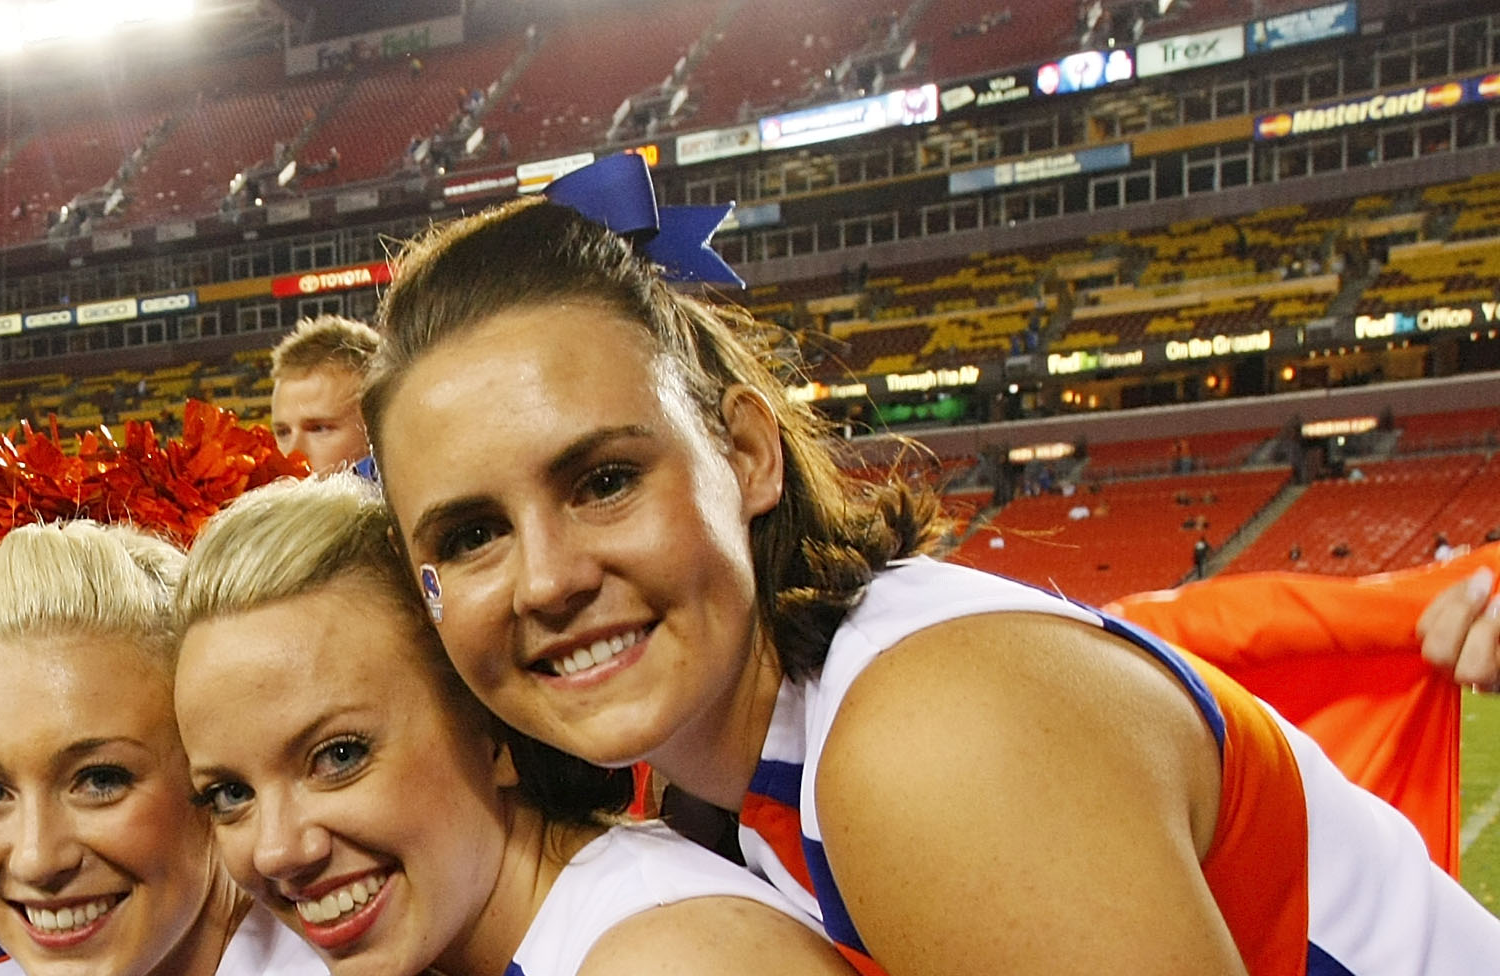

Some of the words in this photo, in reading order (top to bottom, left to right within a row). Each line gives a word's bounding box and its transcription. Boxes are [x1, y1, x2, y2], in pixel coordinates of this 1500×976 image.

[1160, 36, 1221, 64] Trex
[1292, 88, 1427, 135] MasterCard
[319, 268, 372, 289] TOYOTA
[1354, 311, 1416, 340] FedEx
[1416, 306, 1473, 332] Office
[1166, 340, 1188, 361] On
[1188, 337, 1212, 358] the
[1212, 329, 1271, 356] Ground
[885, 371, 936, 393] Through
[959, 364, 980, 385] Air
